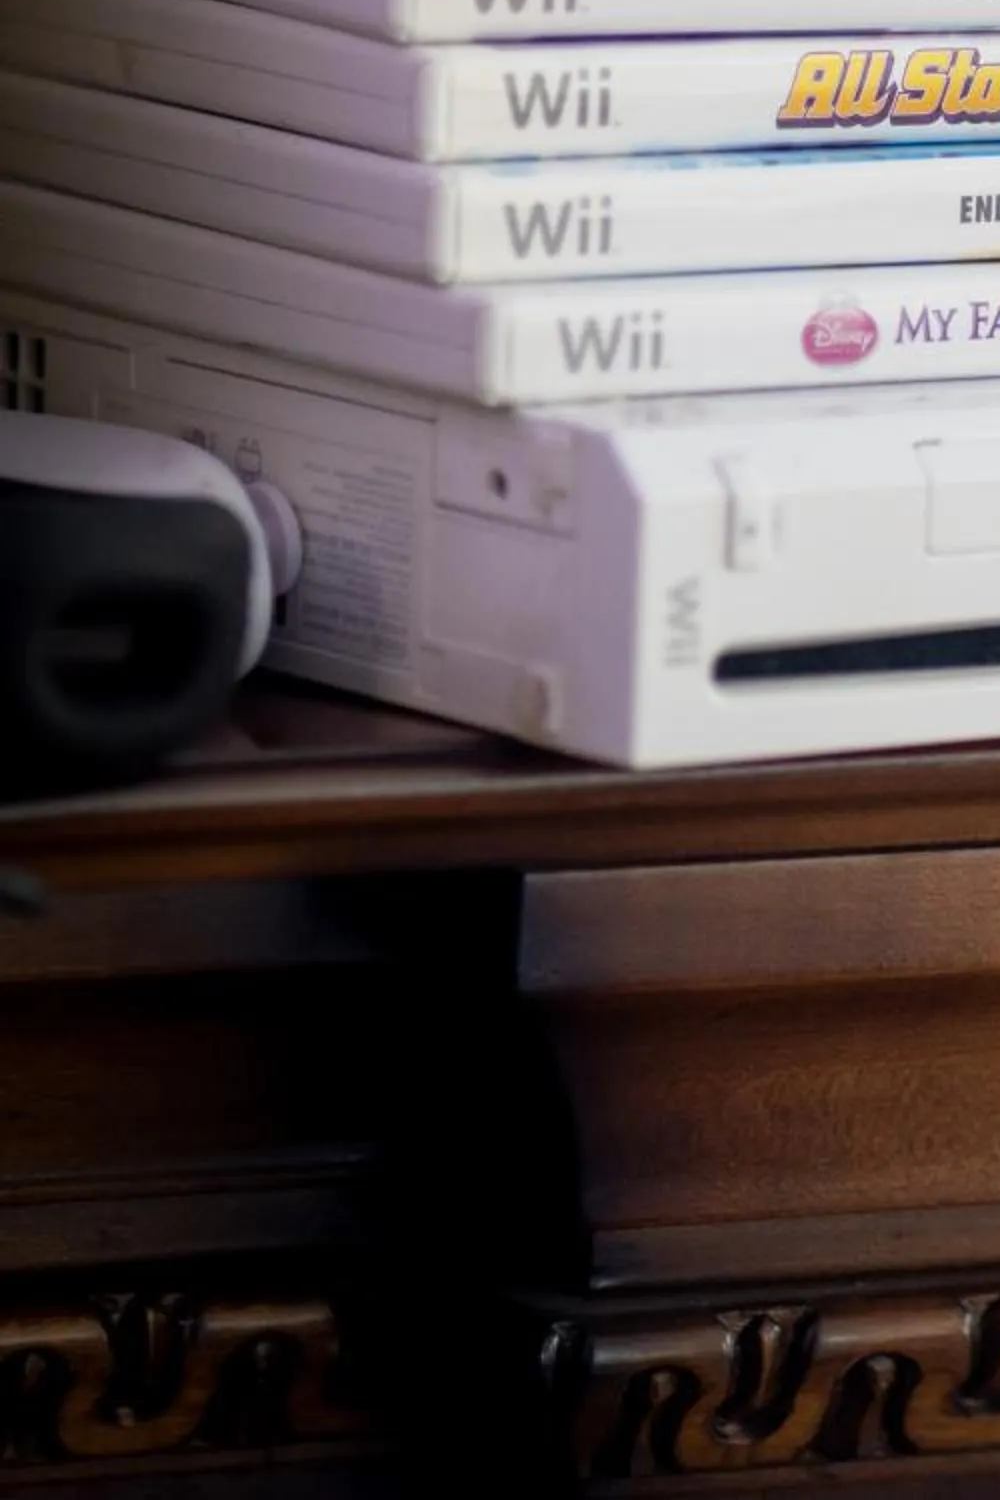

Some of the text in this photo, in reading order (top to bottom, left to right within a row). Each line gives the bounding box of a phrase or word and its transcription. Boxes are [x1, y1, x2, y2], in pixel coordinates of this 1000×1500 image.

[503, 67, 612, 130] Wii
[503, 195, 613, 260] Wii
[557, 310, 665, 374] Wii
